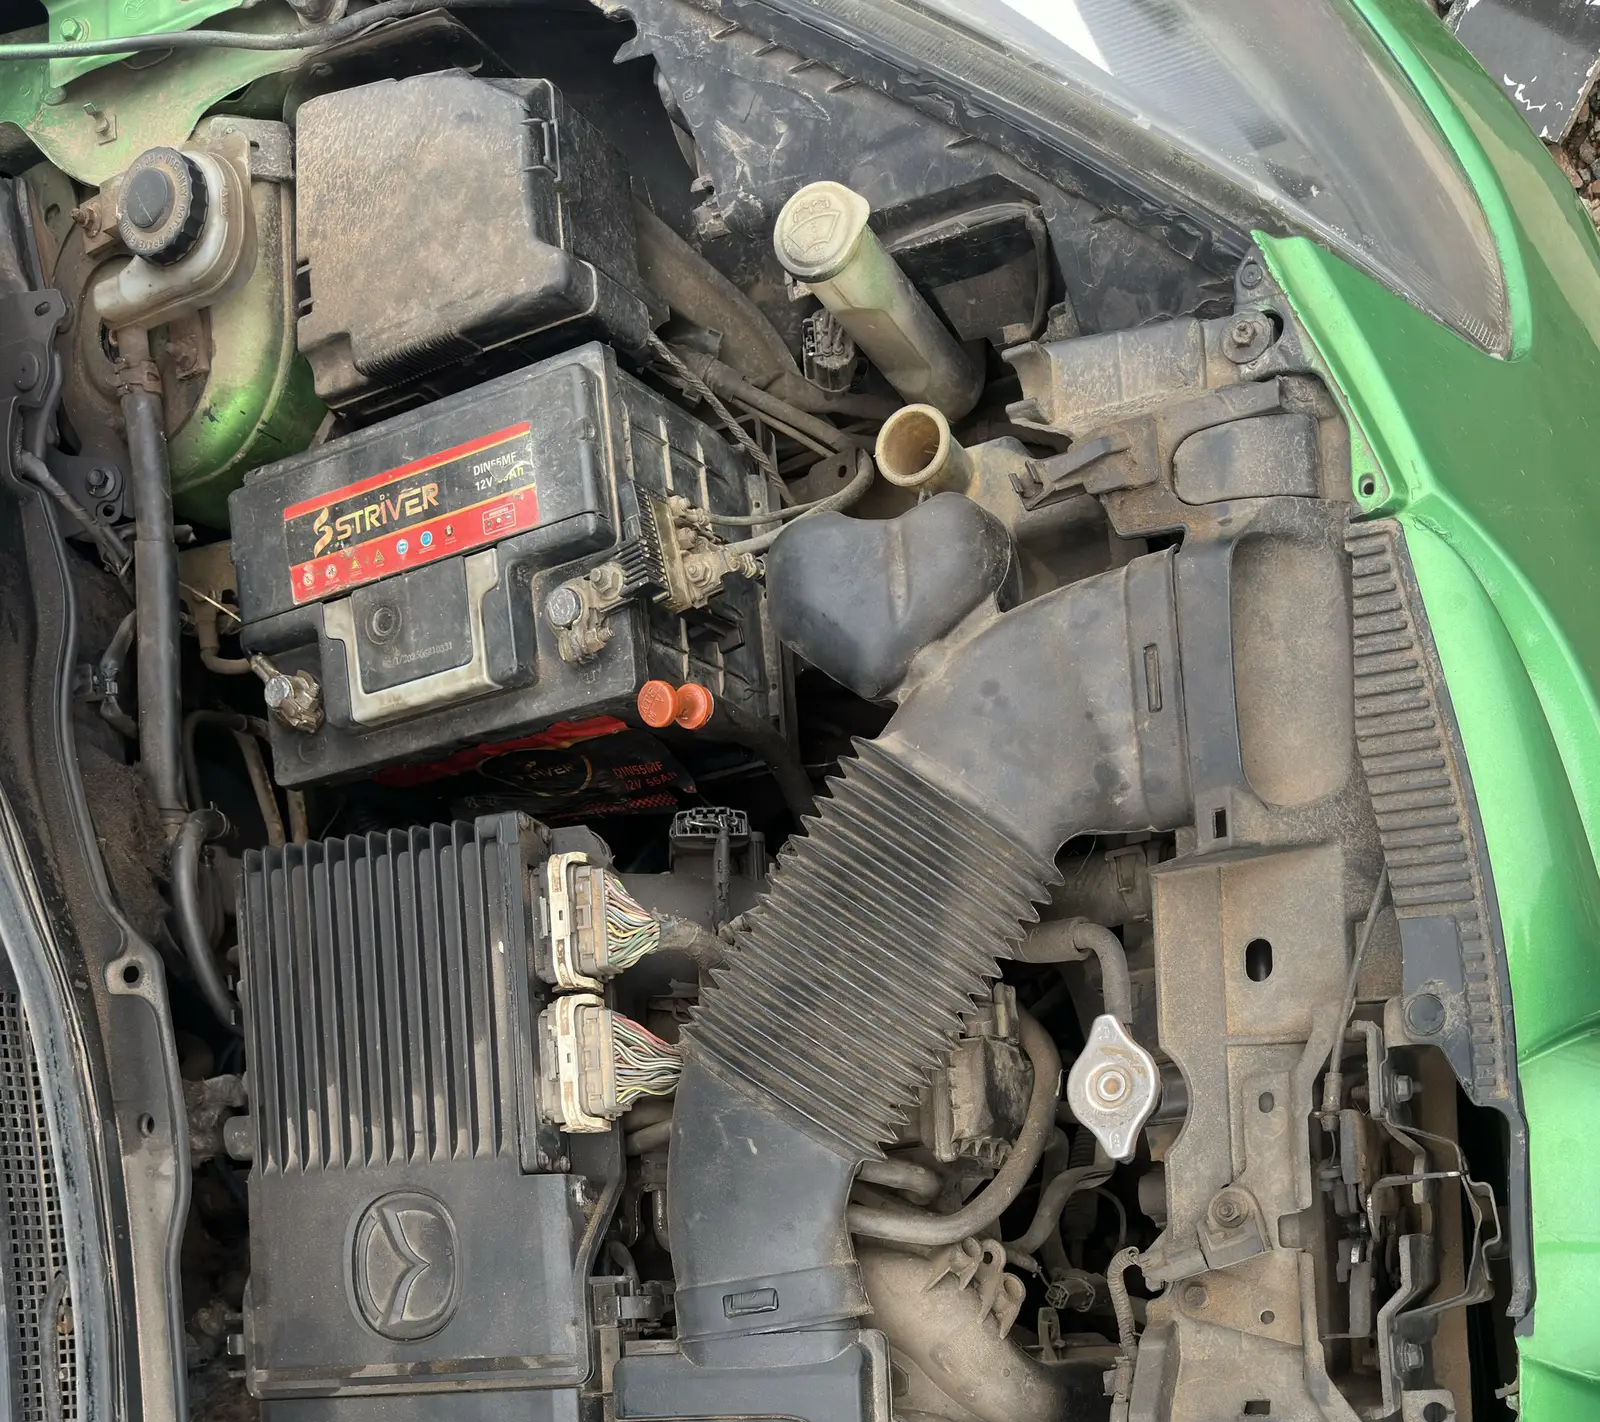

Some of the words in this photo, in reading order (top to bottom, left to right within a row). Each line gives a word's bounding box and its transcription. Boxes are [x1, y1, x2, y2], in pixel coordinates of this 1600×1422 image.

[138, 235, 165, 250] BRAKE
[475, 476, 493, 491] 12V
[334, 482, 439, 541] STRIVER
